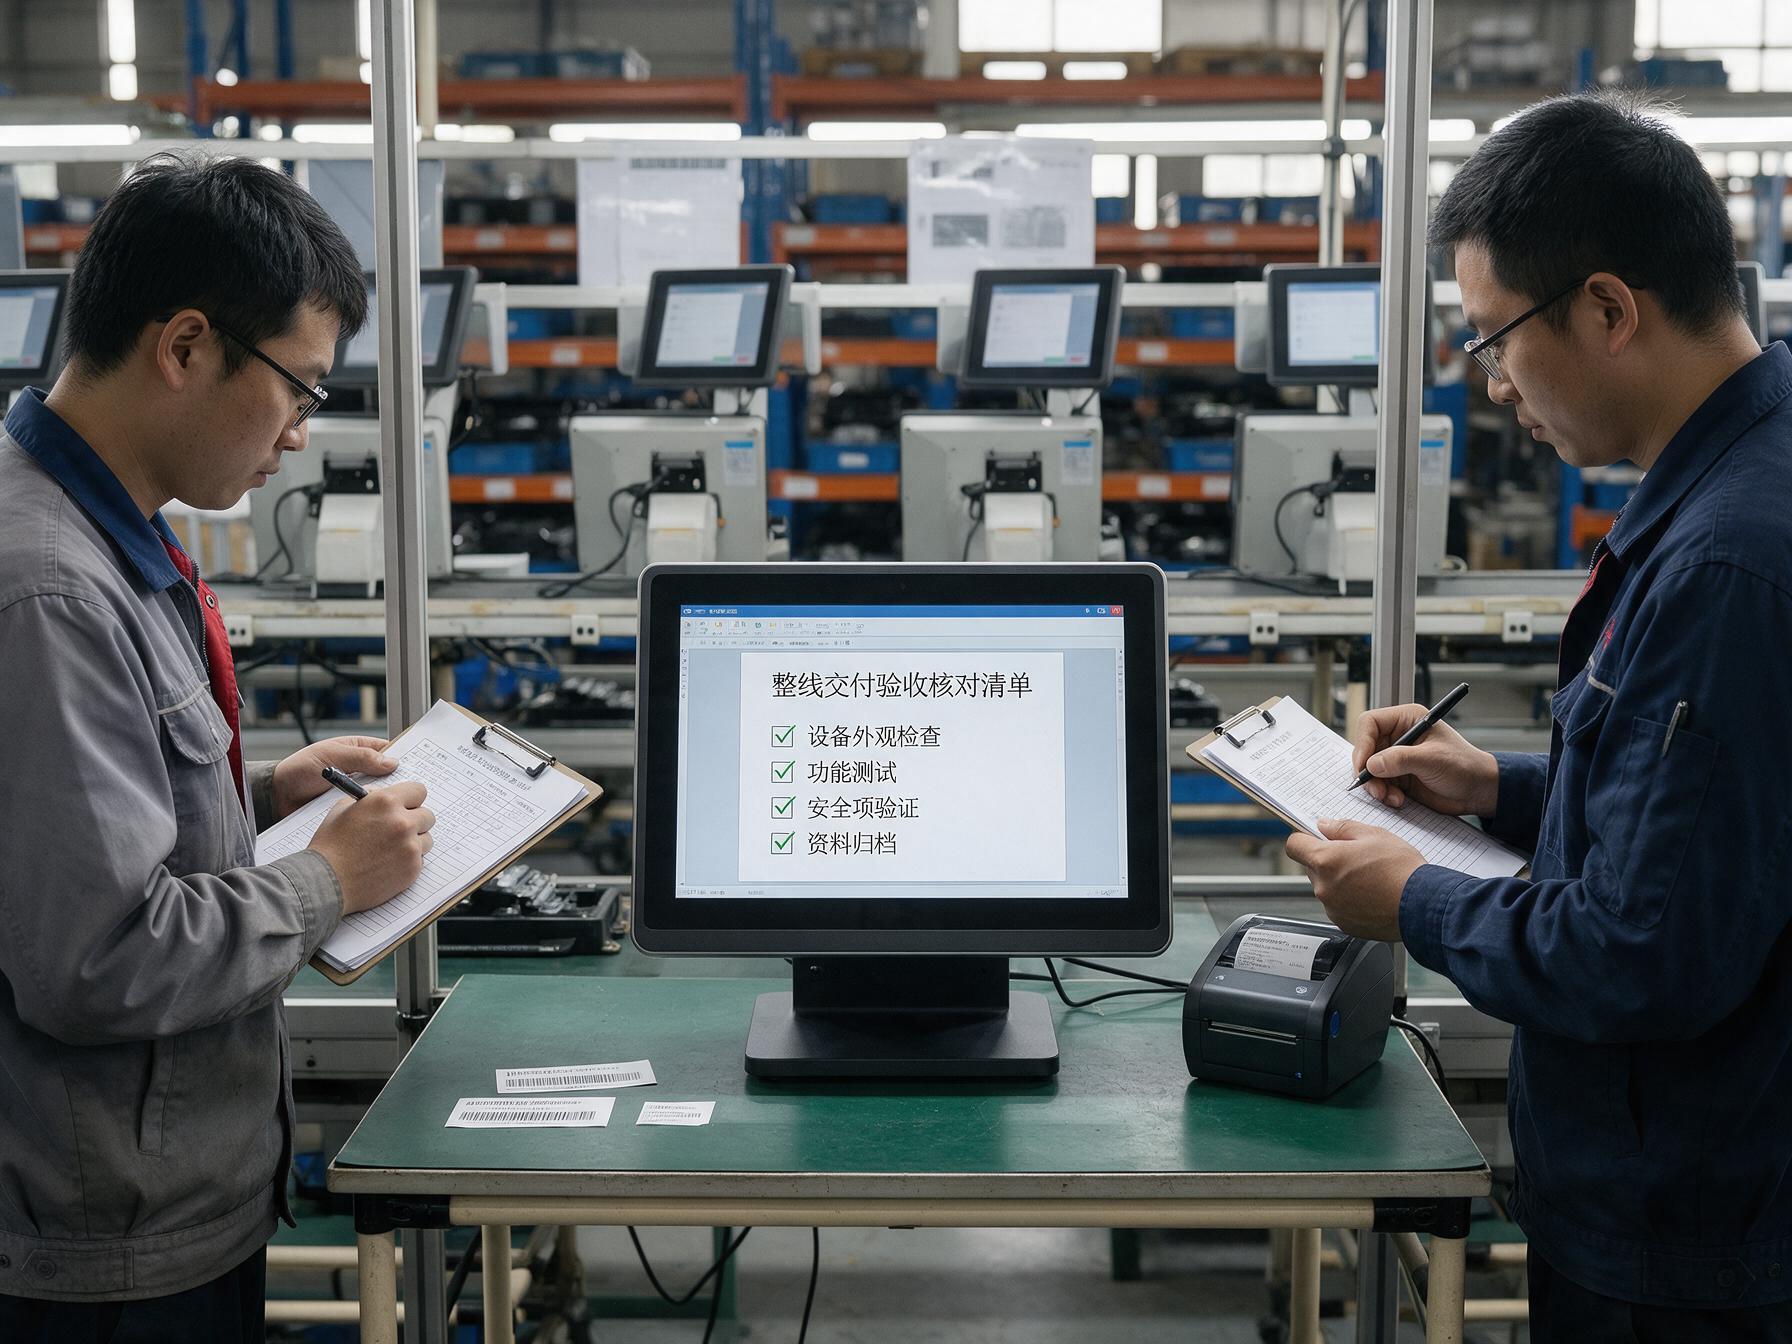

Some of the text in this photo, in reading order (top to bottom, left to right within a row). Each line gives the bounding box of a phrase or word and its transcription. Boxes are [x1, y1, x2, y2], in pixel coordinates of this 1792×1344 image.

[772, 671, 1033, 698] 整线交付验收核对清单
[807, 725, 941, 748] 设备外观检查
[807, 760, 897, 784] 功能测试
[807, 795, 920, 820] 安全项验证
[807, 831, 897, 855] 资料归档
